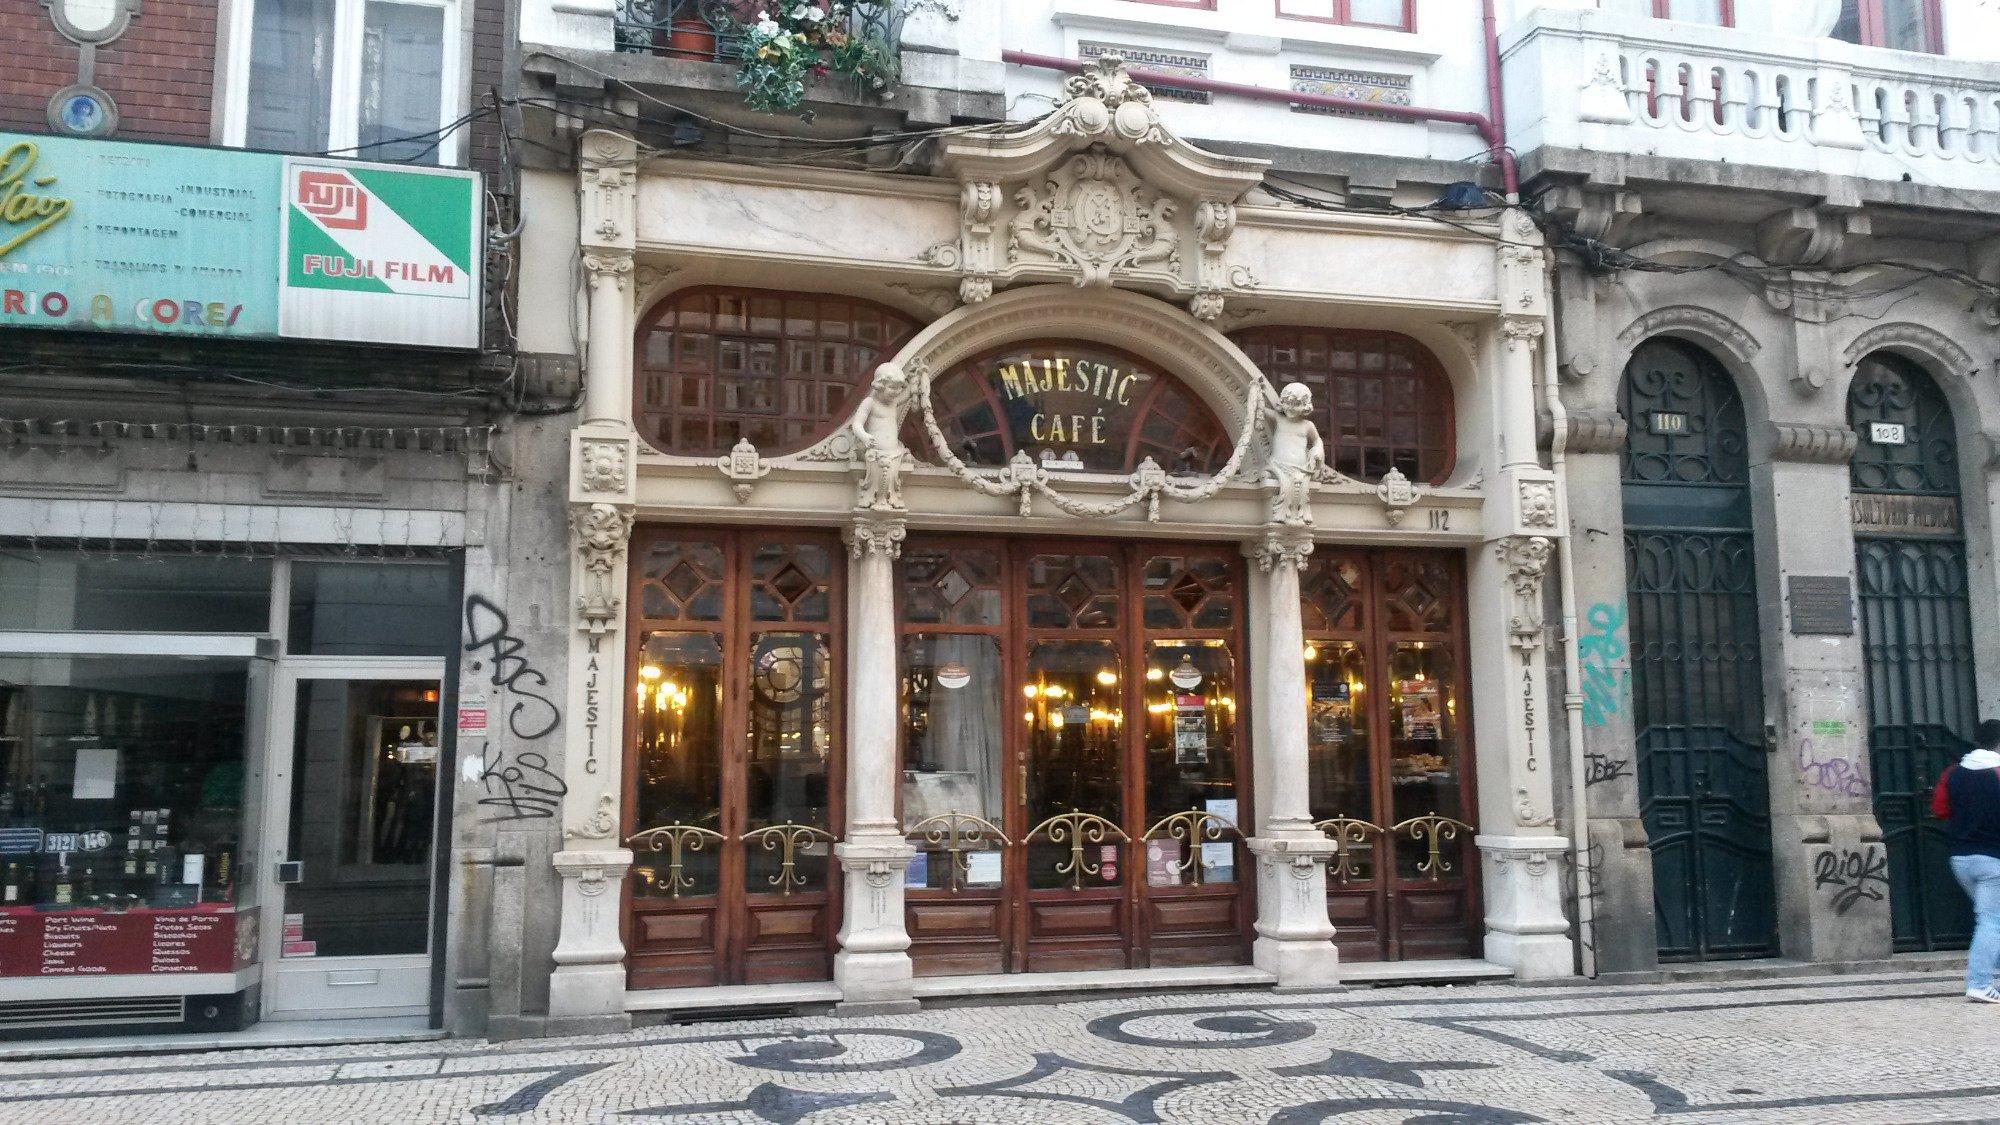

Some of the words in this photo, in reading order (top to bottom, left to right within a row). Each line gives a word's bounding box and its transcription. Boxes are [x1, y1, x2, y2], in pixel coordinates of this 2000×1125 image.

[303, 254, 375, 279] FUJI
[384, 261, 454, 284] FILM
[91, 294, 114, 325] A
[134, 298, 243, 327] CORES
[999, 358, 1138, 407] MAJESTIC
[1030, 407, 1107, 445] CAFÉ
[1656, 413, 1682, 431] 110
[1876, 426, 1900, 441] 108
[1429, 509, 1450, 531] 112
[585, 636, 602, 776] MAJESTIC
[1521, 652, 1537, 772] MAJESTIC
